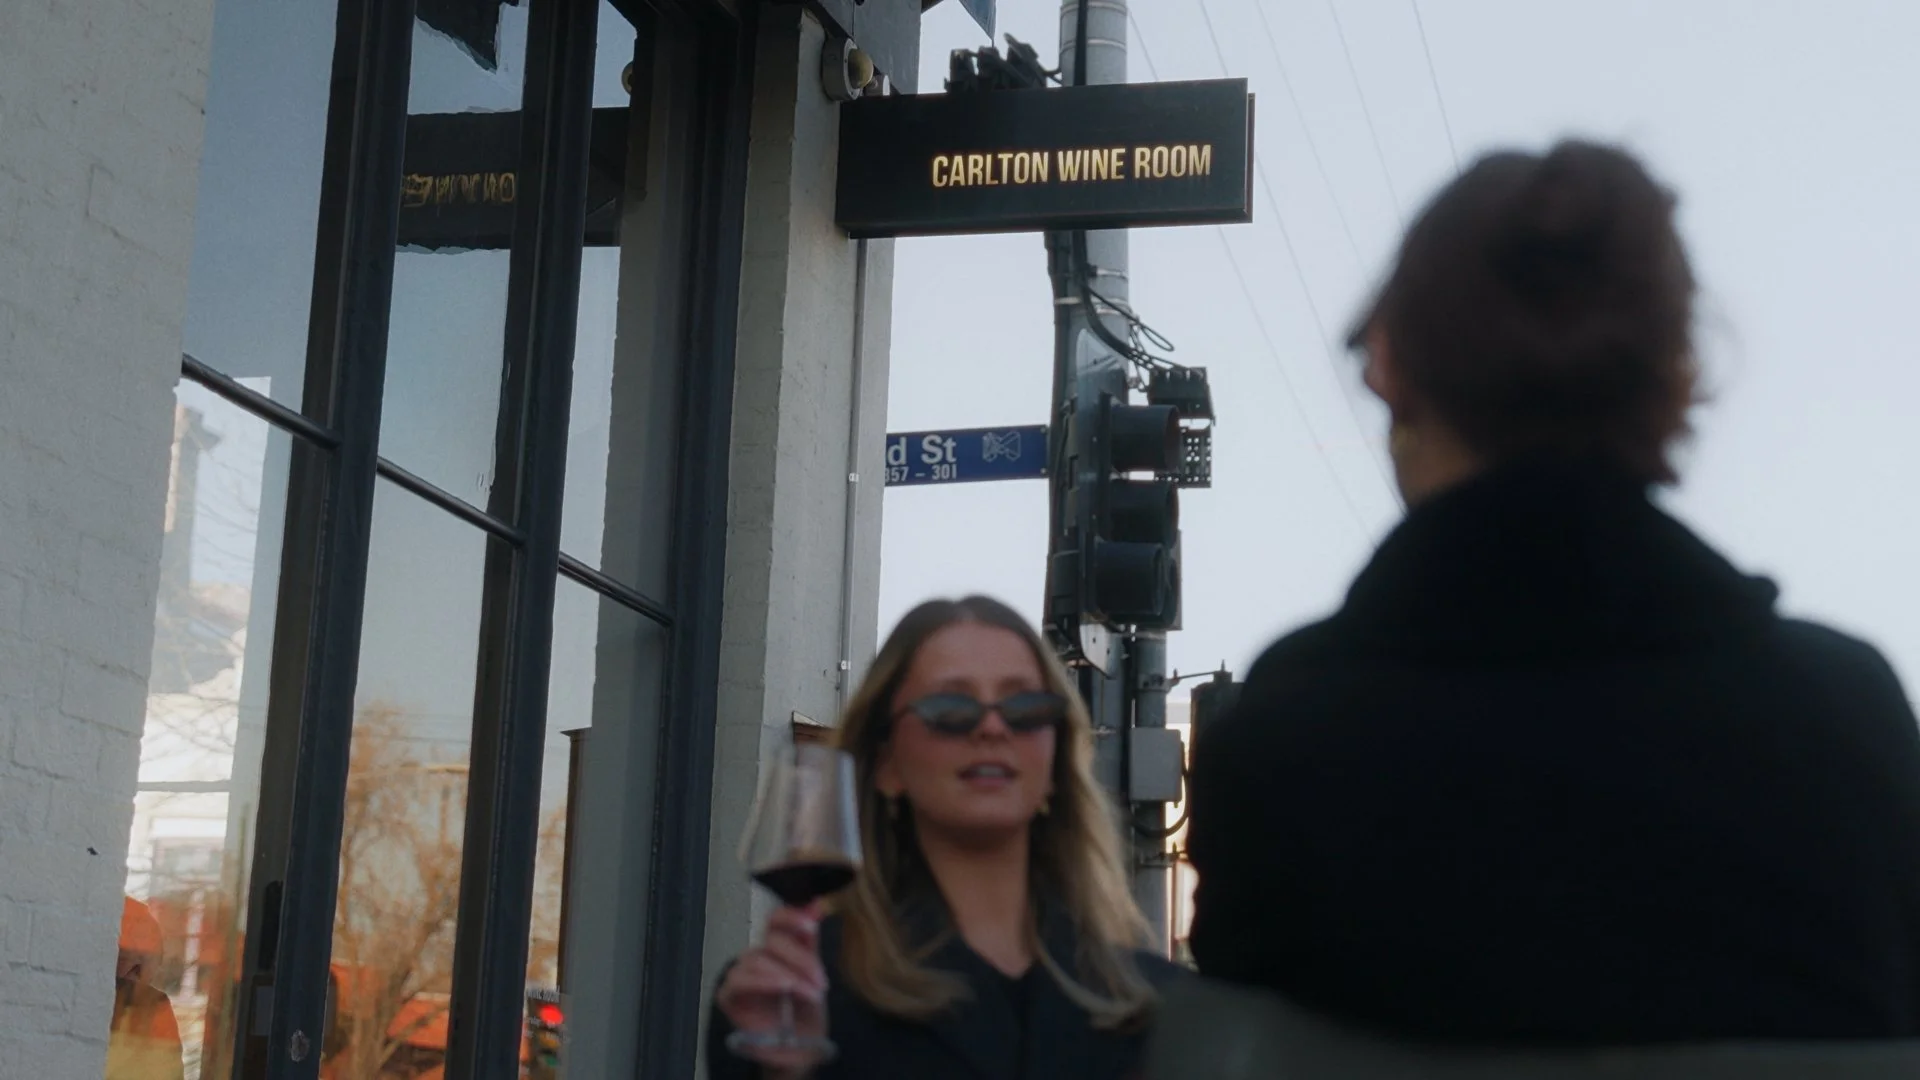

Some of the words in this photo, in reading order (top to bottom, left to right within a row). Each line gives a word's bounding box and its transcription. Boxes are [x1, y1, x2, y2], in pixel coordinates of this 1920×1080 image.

[932, 151, 1049, 187] CARLTON
[1057, 147, 1126, 182] WINE
[1134, 144, 1212, 179] ROOM
[921, 433, 957, 464] St
[931, 463, 957, 481] 301
